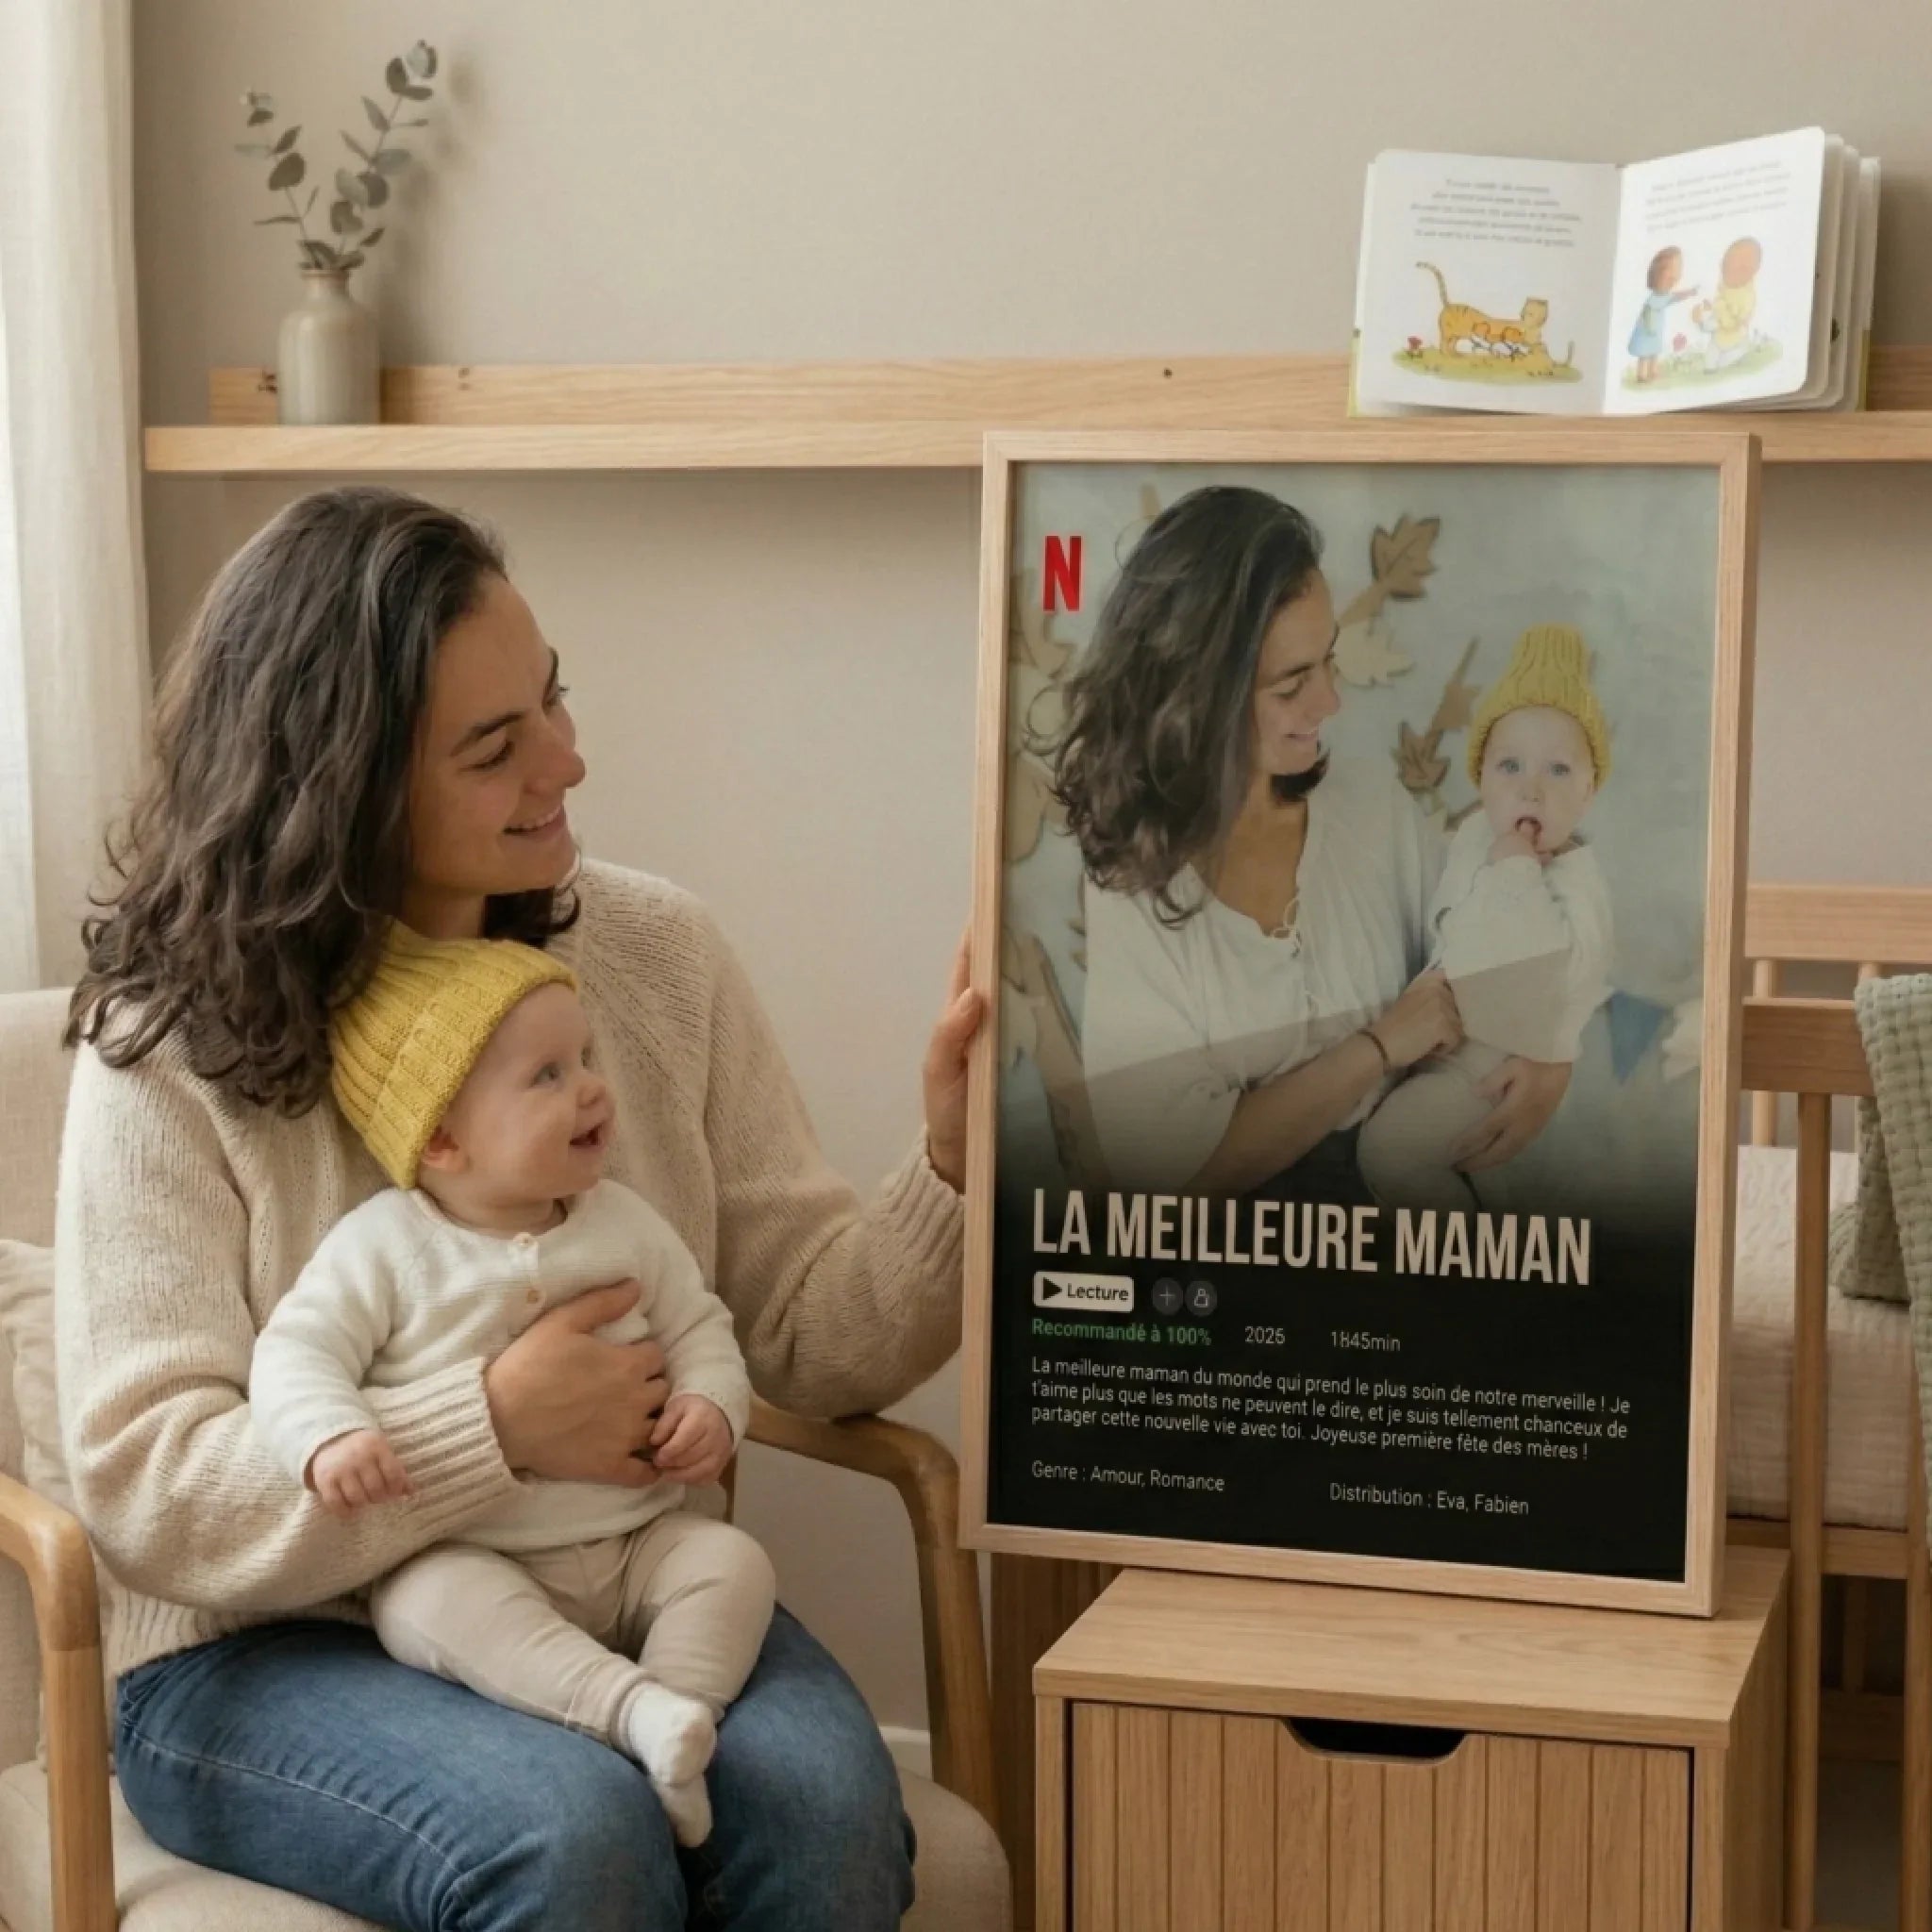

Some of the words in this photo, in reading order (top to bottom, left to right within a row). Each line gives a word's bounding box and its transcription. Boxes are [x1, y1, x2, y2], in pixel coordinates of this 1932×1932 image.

[1043, 536, 1081, 611] N
[1033, 1188, 1091, 1256] LA
[1107, 1192, 1379, 1273] MEILLEURE
[1395, 1209, 1591, 1286] MAMAN
[1067, 1283, 1129, 1301] Lecture
[1032, 1319, 1146, 1342] Recommandé
[1151, 1324, 1161, 1342] à
[1166, 1326, 1212, 1346] 100%
[1032, 1357, 1050, 1373] La
[1056, 1358, 1125, 1378] meilleure
[1130, 1365, 1189, 1383] maman
[1193, 1367, 1212, 1385] du
[1218, 1370, 1273, 1390] monde
[1276, 1373, 1301, 1394] qui
[1305, 1376, 1350, 1396] prend
[1356, 1377, 1369, 1395] le
[1374, 1378, 1407, 1401] plus
[1412, 1382, 1446, 1401] soin
[1450, 1384, 1471, 1403] de
[1474, 1389, 1517, 1407] notre
[1522, 1391, 1596, 1412] merveille
[1610, 1396, 1631, 1414] Je
[1032, 1380, 1078, 1399] t'aime
[1082, 1383, 1114, 1404] plus
[1118, 1389, 1147, 1406] que
[1151, 1387, 1173, 1406] les
[1178, 1392, 1218, 1408] mots
[1223, 1396, 1241, 1410] ne
[1245, 1397, 1308, 1416] peuvent
[1312, 1398, 1326, 1415] le
[1330, 1401, 1364, 1423] dire,
[1369, 1405, 1384, 1422] et
[1387, 1405, 1403, 1426] je
[1407, 1407, 1439, 1425] suis
[1443, 1409, 1520, 1431] tellement
[1524, 1414, 1603, 1437] chanceux
[1607, 1420, 1627, 1439] de
[1032, 1406, 1097, 1426] partager
[1101, 1410, 1141, 1427] cette
[1144, 1414, 1210, 1433] nouvelle
[1213, 1416, 1237, 1435] vie
[1241, 1422, 1276, 1437] avec
[1310, 1424, 1378, 1446] Joyeuse
[1381, 1429, 1453, 1450] première
[1457, 1433, 1489, 1452] fête
[1492, 1436, 1523, 1456] des
[1527, 1439, 1578, 1459] mères
[1032, 1459, 1078, 1480] Genre
[1091, 1466, 1146, 1488] Amour,
[1151, 1469, 1225, 1491] Romance
[1329, 1482, 1424, 1507] Distribution
[1437, 1490, 1469, 1512] Eva,
[1474, 1493, 1529, 1515] Fabien
